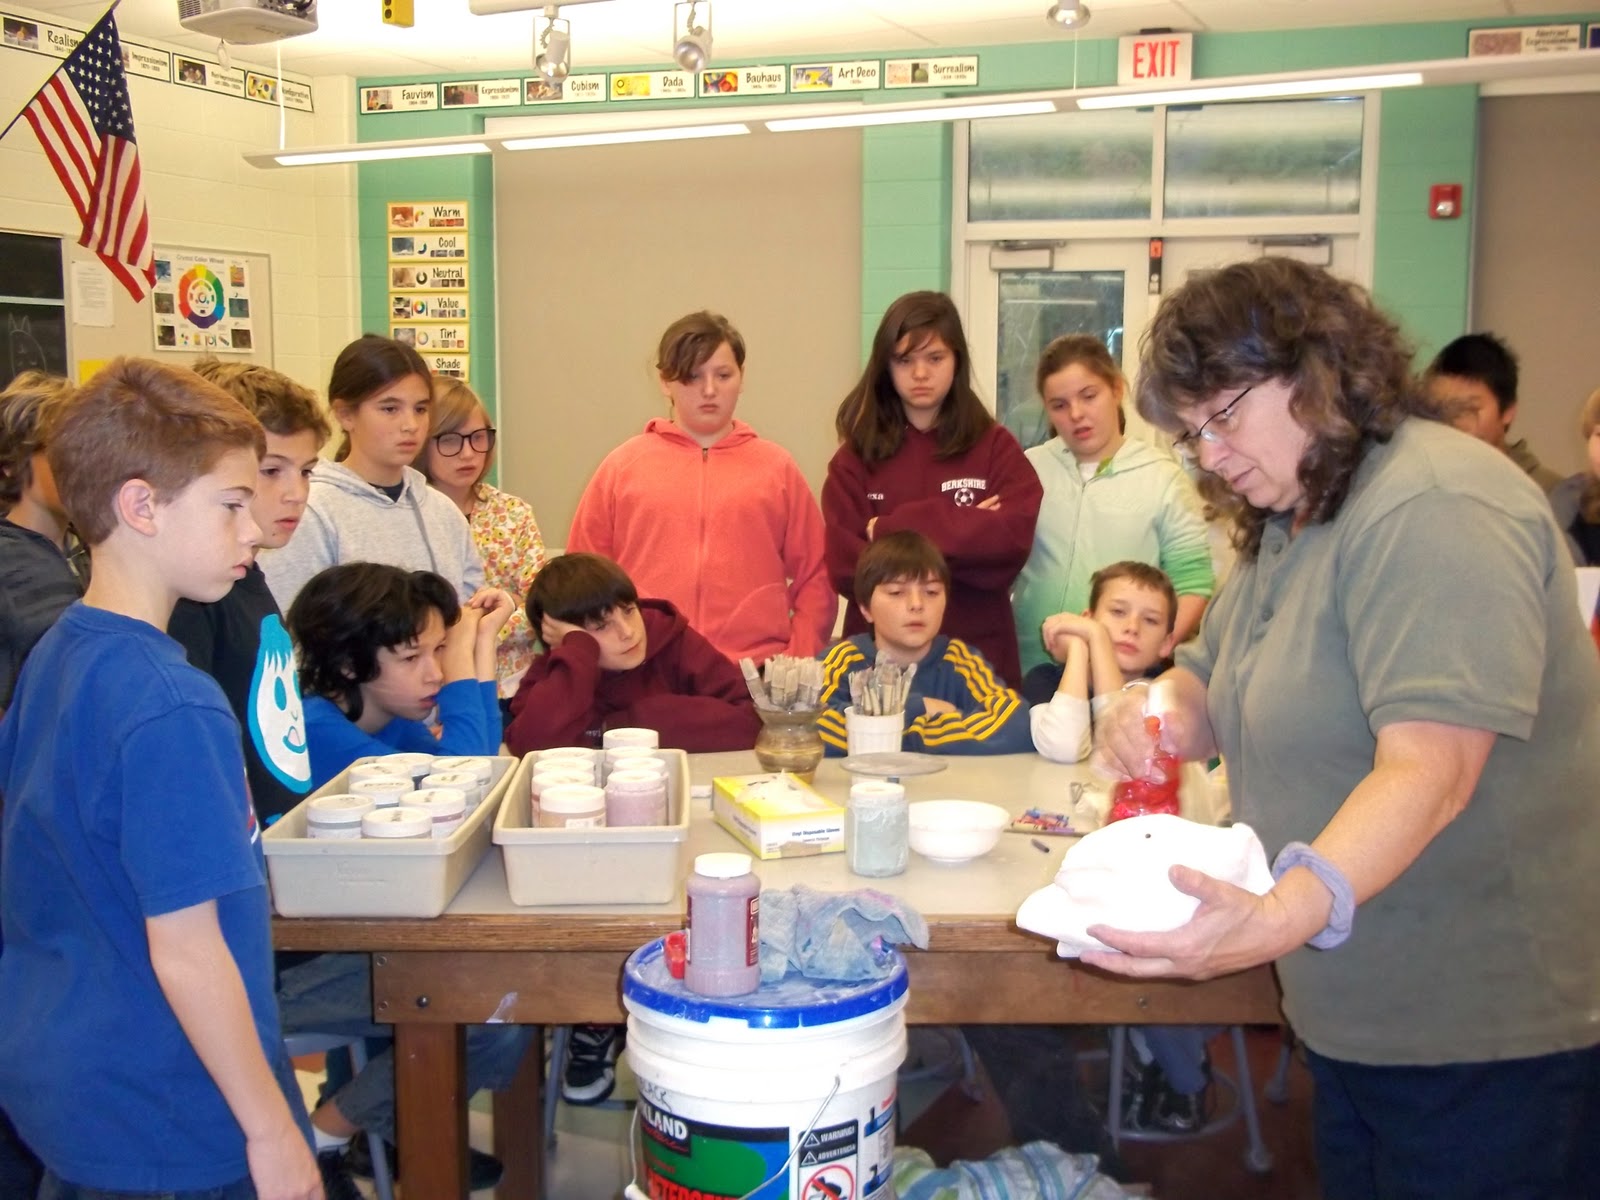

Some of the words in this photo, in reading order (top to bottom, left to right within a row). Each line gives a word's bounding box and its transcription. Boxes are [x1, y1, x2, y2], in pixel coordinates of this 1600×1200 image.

[1133, 40, 1180, 78] EXIT
[838, 67, 855, 79] Art
[856, 66, 877, 78] Deco
[933, 63, 975, 74] Surrealism
[662, 76, 684, 87] Dada
[746, 72, 782, 84] Bauhaus
[571, 80, 600, 92] Cubism
[402, 89, 435, 100] Fauvism
[433, 207, 461, 218] Warm
[438, 237, 456, 248] Cool
[432, 267, 463, 279] Neutral
[437, 298, 459, 309] Value
[439, 328, 457, 339] Tint
[436, 358, 461, 369] Shade
[941, 478, 987, 492] BERKSHIRE
